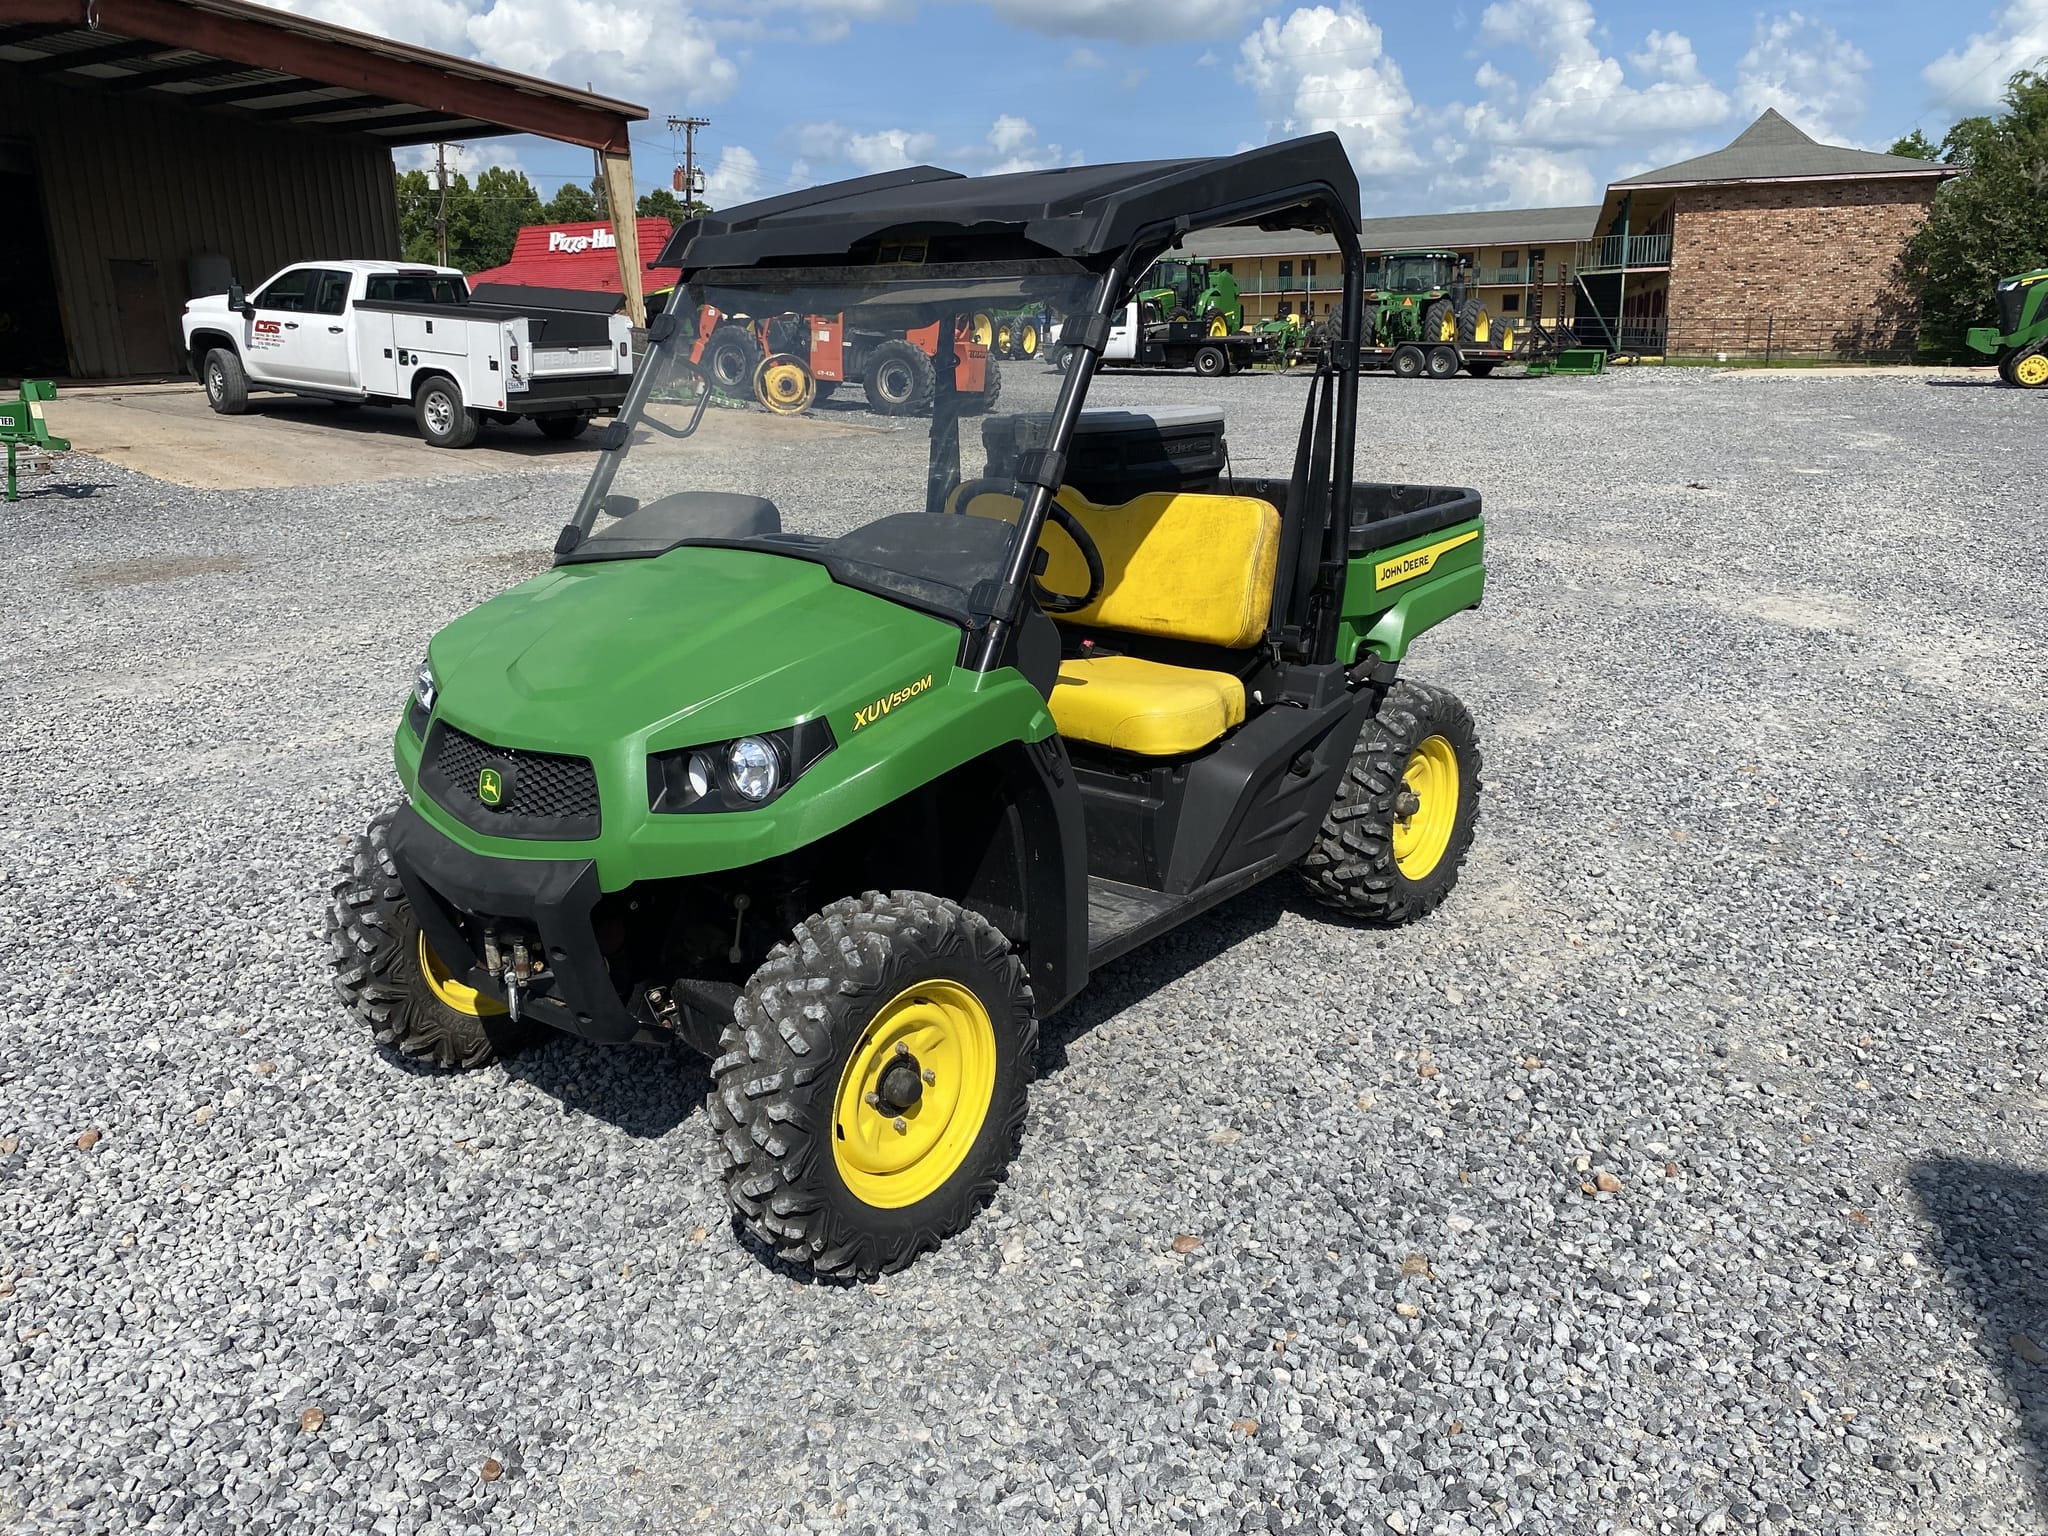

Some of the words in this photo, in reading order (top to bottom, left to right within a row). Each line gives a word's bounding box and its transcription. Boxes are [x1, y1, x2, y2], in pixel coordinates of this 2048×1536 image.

[549, 231, 588, 253] Pizza
[591, 228, 617, 249] Hu
[1381, 565, 1402, 581] JOHN
[1403, 555, 1430, 573] DEERE
[852, 673, 933, 732] XUV590M
